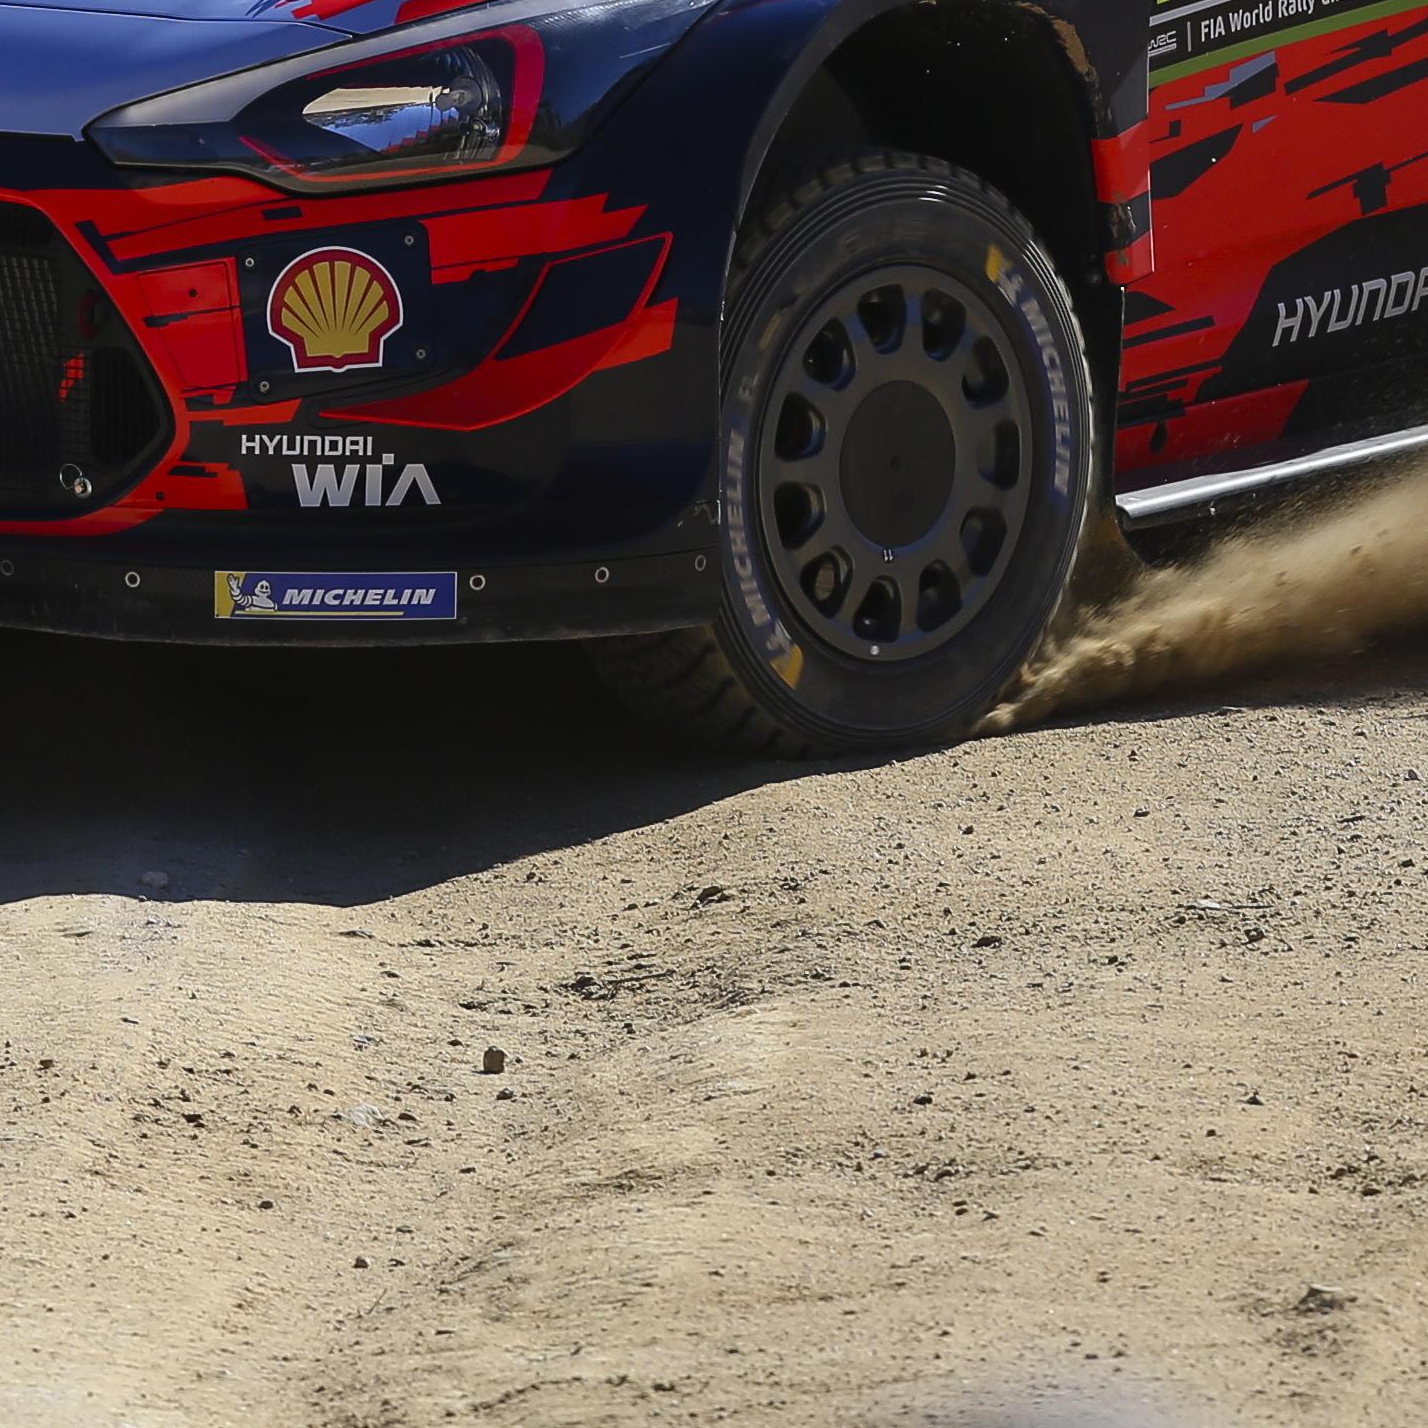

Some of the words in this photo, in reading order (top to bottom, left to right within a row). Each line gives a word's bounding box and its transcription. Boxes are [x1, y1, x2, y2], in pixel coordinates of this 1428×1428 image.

[1200, 15, 1226, 43] FIA
[1229, 0, 1273, 31] World
[1021, 299, 1070, 496] MICHELIN
[241, 434, 373, 456] HYUNDAI
[282, 588, 437, 606] MICHELIN
